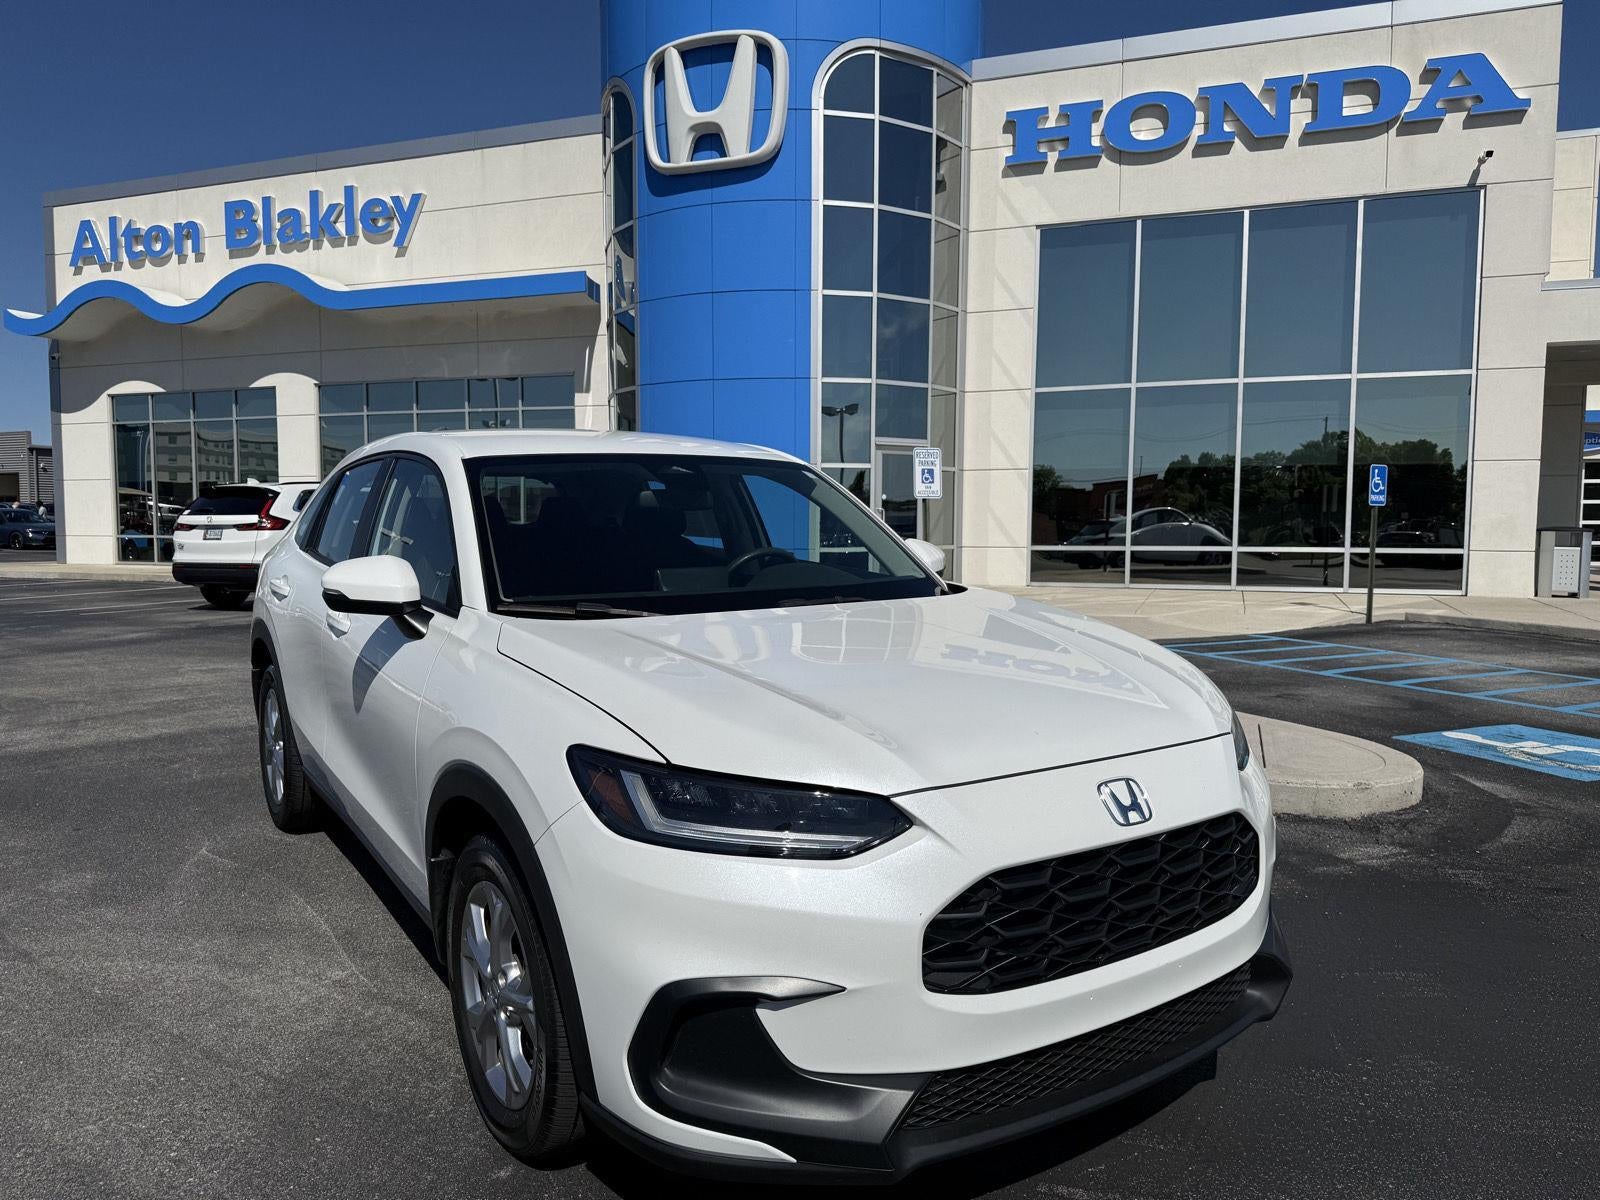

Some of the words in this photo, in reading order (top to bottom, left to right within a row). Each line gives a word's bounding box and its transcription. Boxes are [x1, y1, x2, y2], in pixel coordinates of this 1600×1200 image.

[1004, 52, 1531, 167] HONDA
[69, 215, 202, 269] Alton
[224, 184, 426, 249] Blakley
[916, 451, 939, 460] RESERVED
[918, 460, 937, 468] PARKING
[1370, 494, 1385, 502] PARKING
